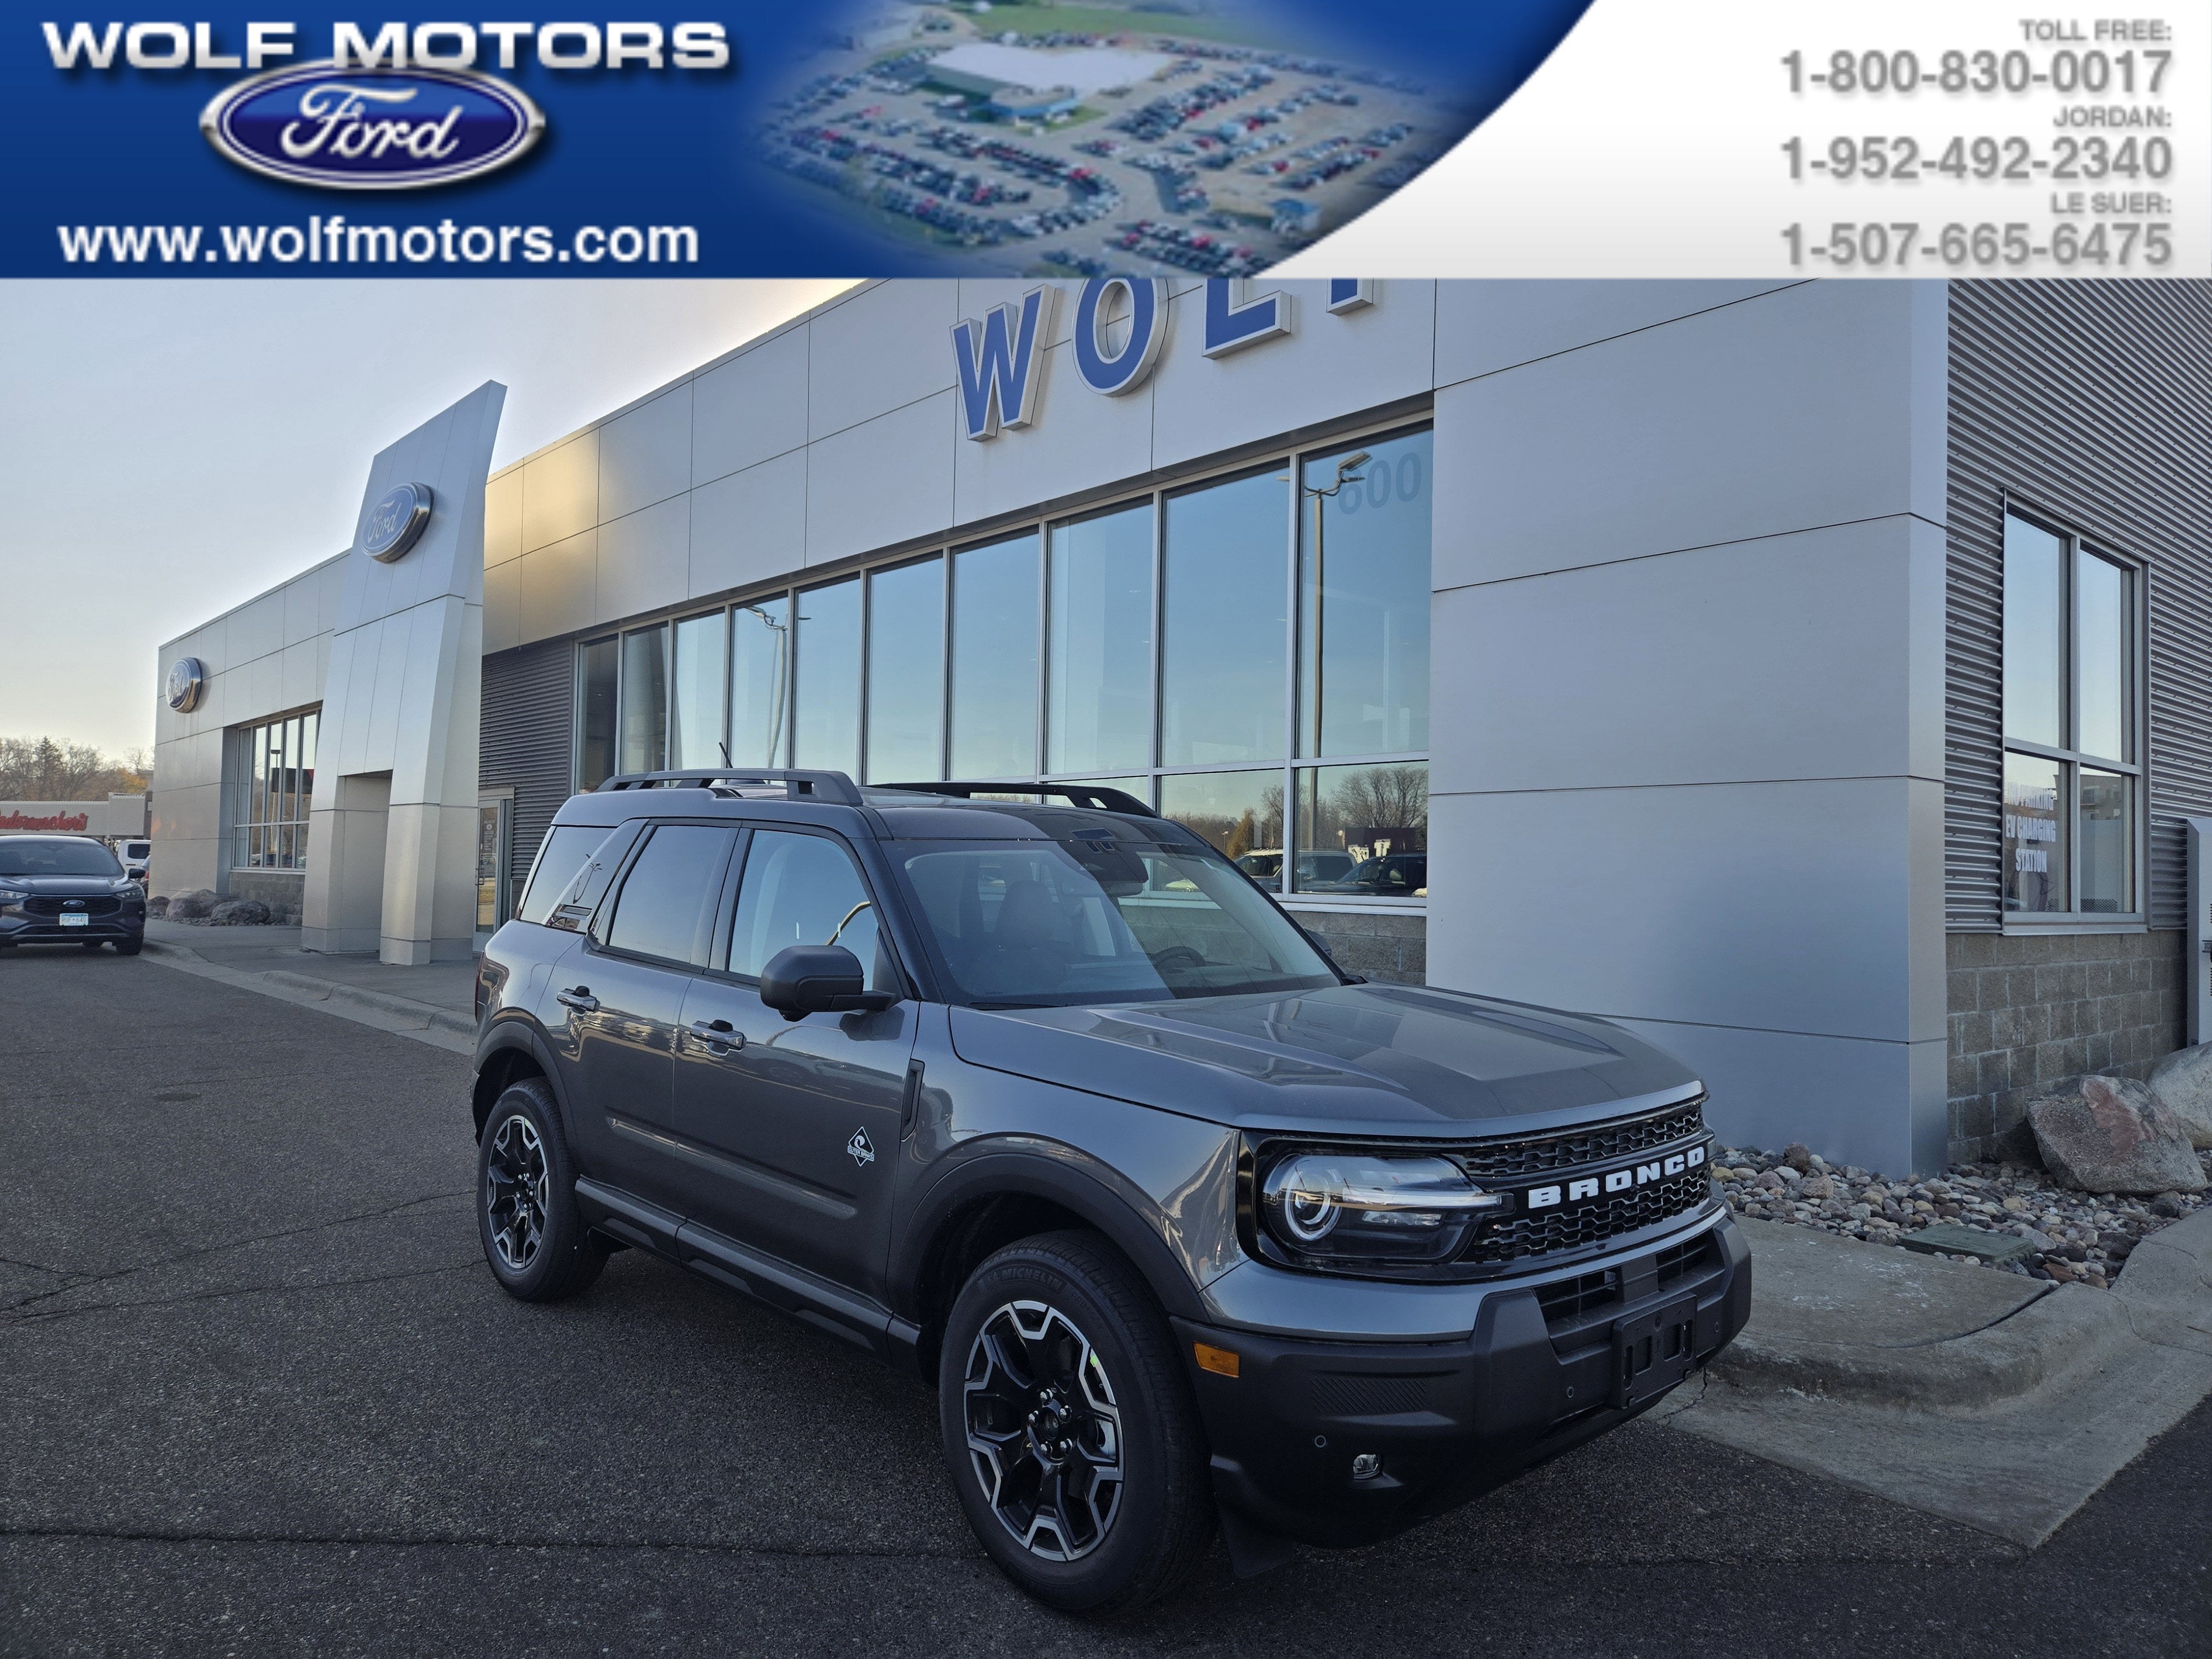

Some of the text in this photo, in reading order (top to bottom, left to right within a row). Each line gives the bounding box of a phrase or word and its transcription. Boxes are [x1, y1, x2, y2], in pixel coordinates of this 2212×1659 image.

[950, 278, 1374, 442] WOL
[1338, 452, 1422, 515] 600
[368, 499, 401, 544] Ford
[2006, 815, 2056, 842] EV CHARGING
[2016, 848, 2047, 873] STATION
[1528, 1146, 1705, 1209] BRONCO
[1002, 1267, 1063, 1291] MICHELIN
